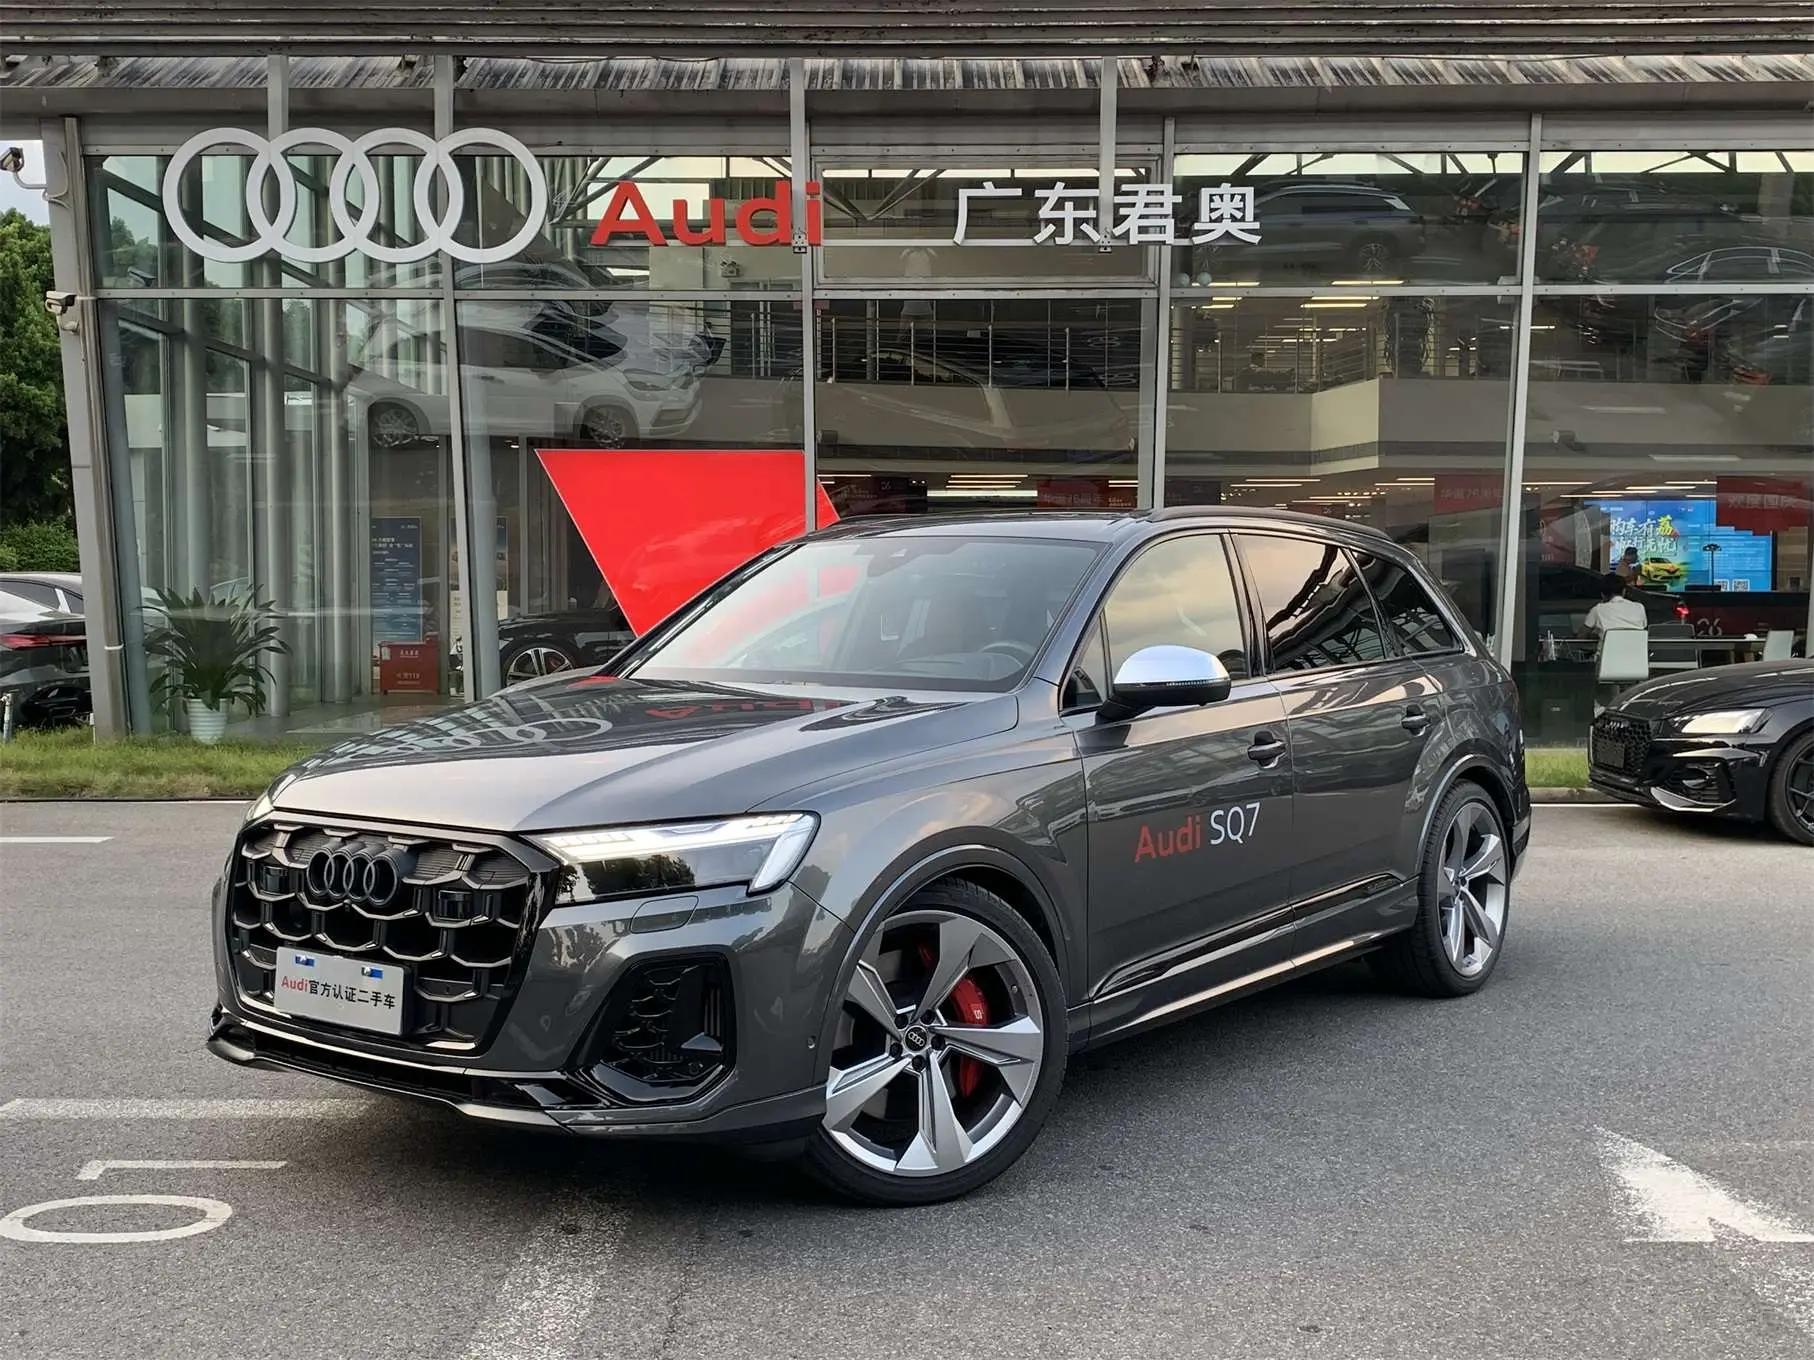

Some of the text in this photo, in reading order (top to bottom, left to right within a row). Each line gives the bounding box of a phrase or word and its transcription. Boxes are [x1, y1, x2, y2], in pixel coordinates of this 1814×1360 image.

[590, 180, 822, 247] Audi
[953, 181, 1263, 245] 广东君奥
[1134, 801, 1261, 863] Audi SQ7
